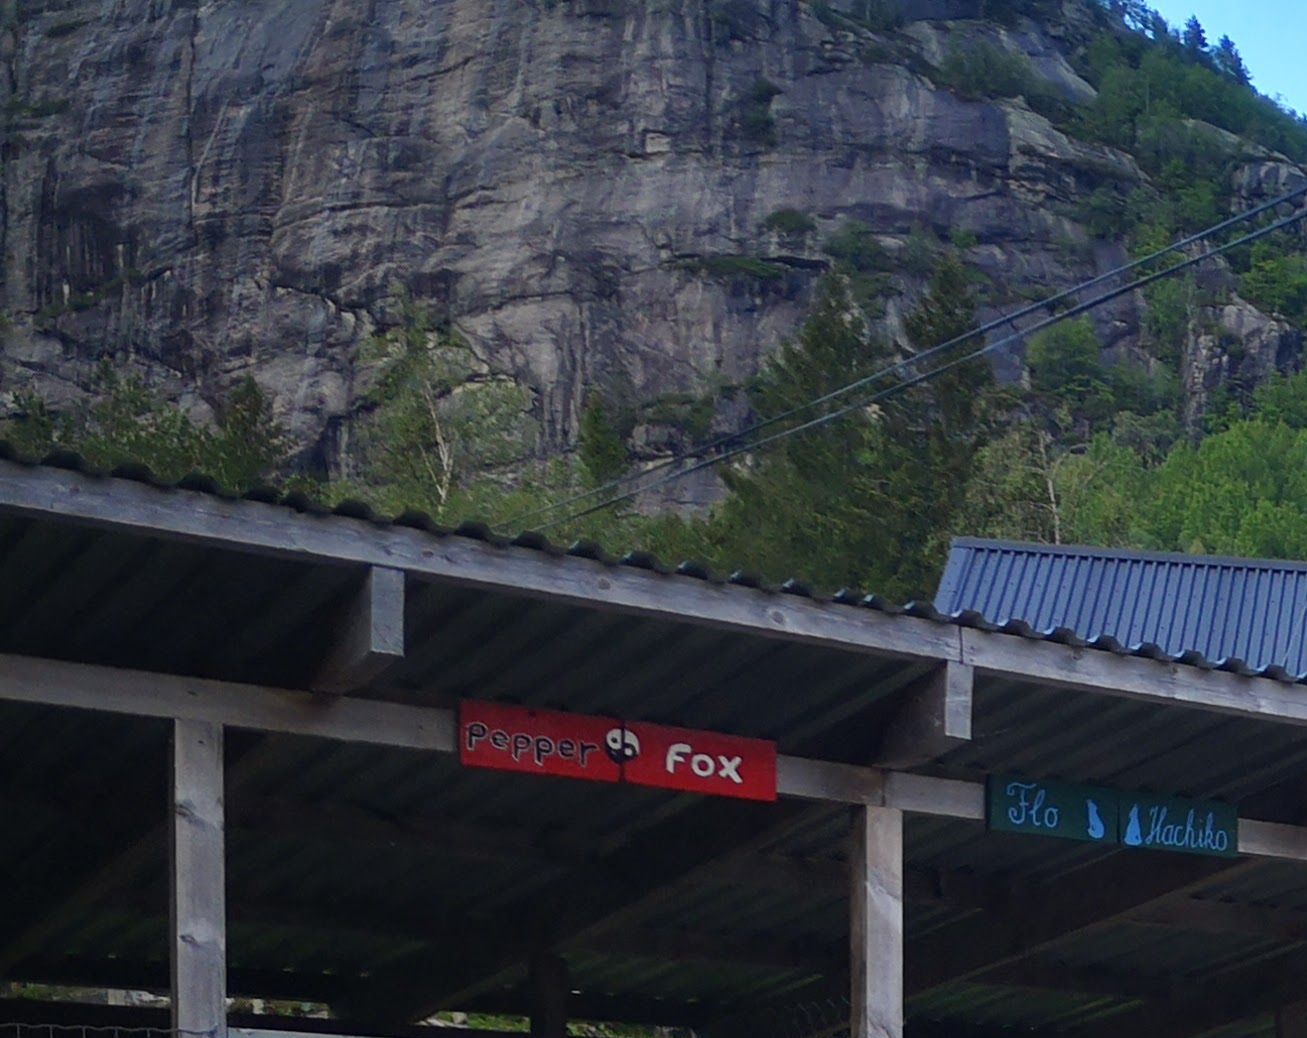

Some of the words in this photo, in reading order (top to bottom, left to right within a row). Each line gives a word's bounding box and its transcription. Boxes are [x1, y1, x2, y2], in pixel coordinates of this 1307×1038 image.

[465, 722, 599, 767] Pepper
[666, 743, 743, 783] Fox
[1006, 782, 1059, 828] Flo
[1145, 805, 1228, 851] Hachiko
